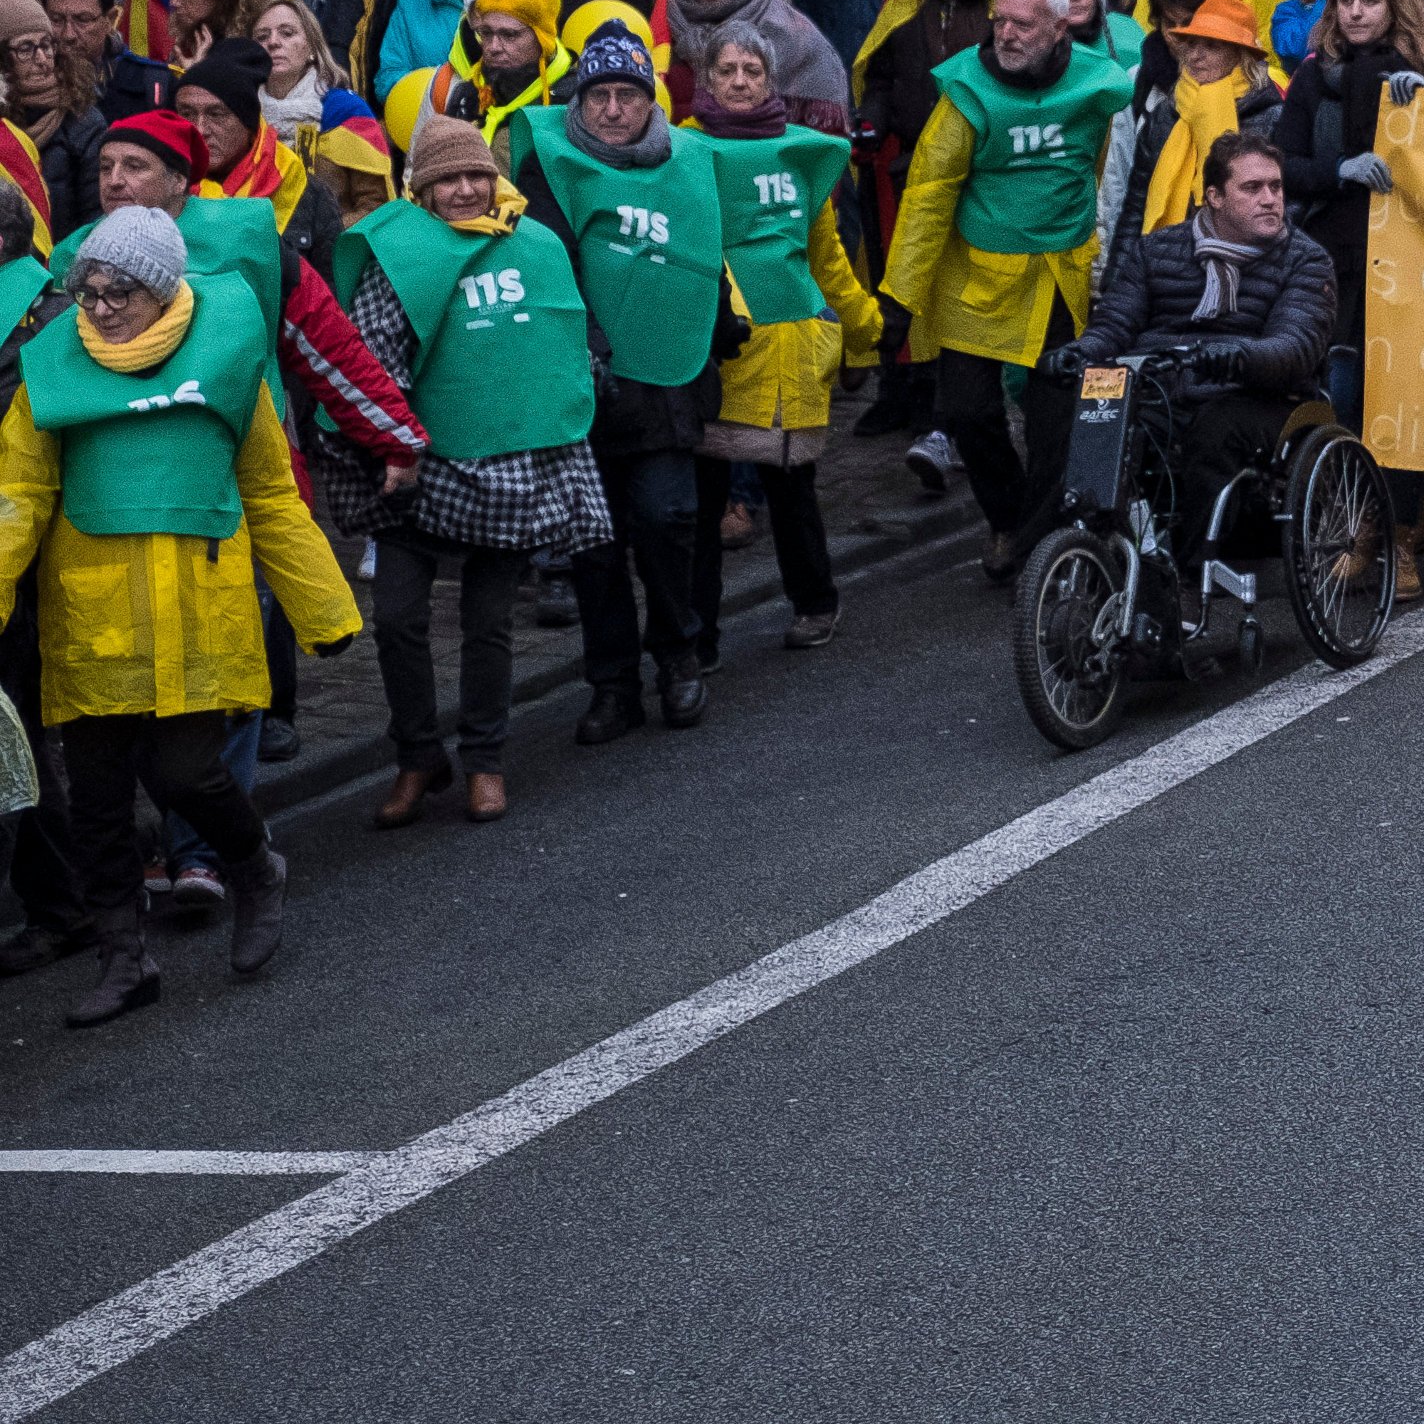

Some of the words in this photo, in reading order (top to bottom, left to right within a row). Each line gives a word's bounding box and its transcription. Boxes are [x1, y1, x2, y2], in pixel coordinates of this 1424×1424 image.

[1008, 123, 1066, 154] 11S
[753, 172, 797, 205] 11S
[617, 205, 671, 245] 11S
[459, 268, 526, 309] 11S
